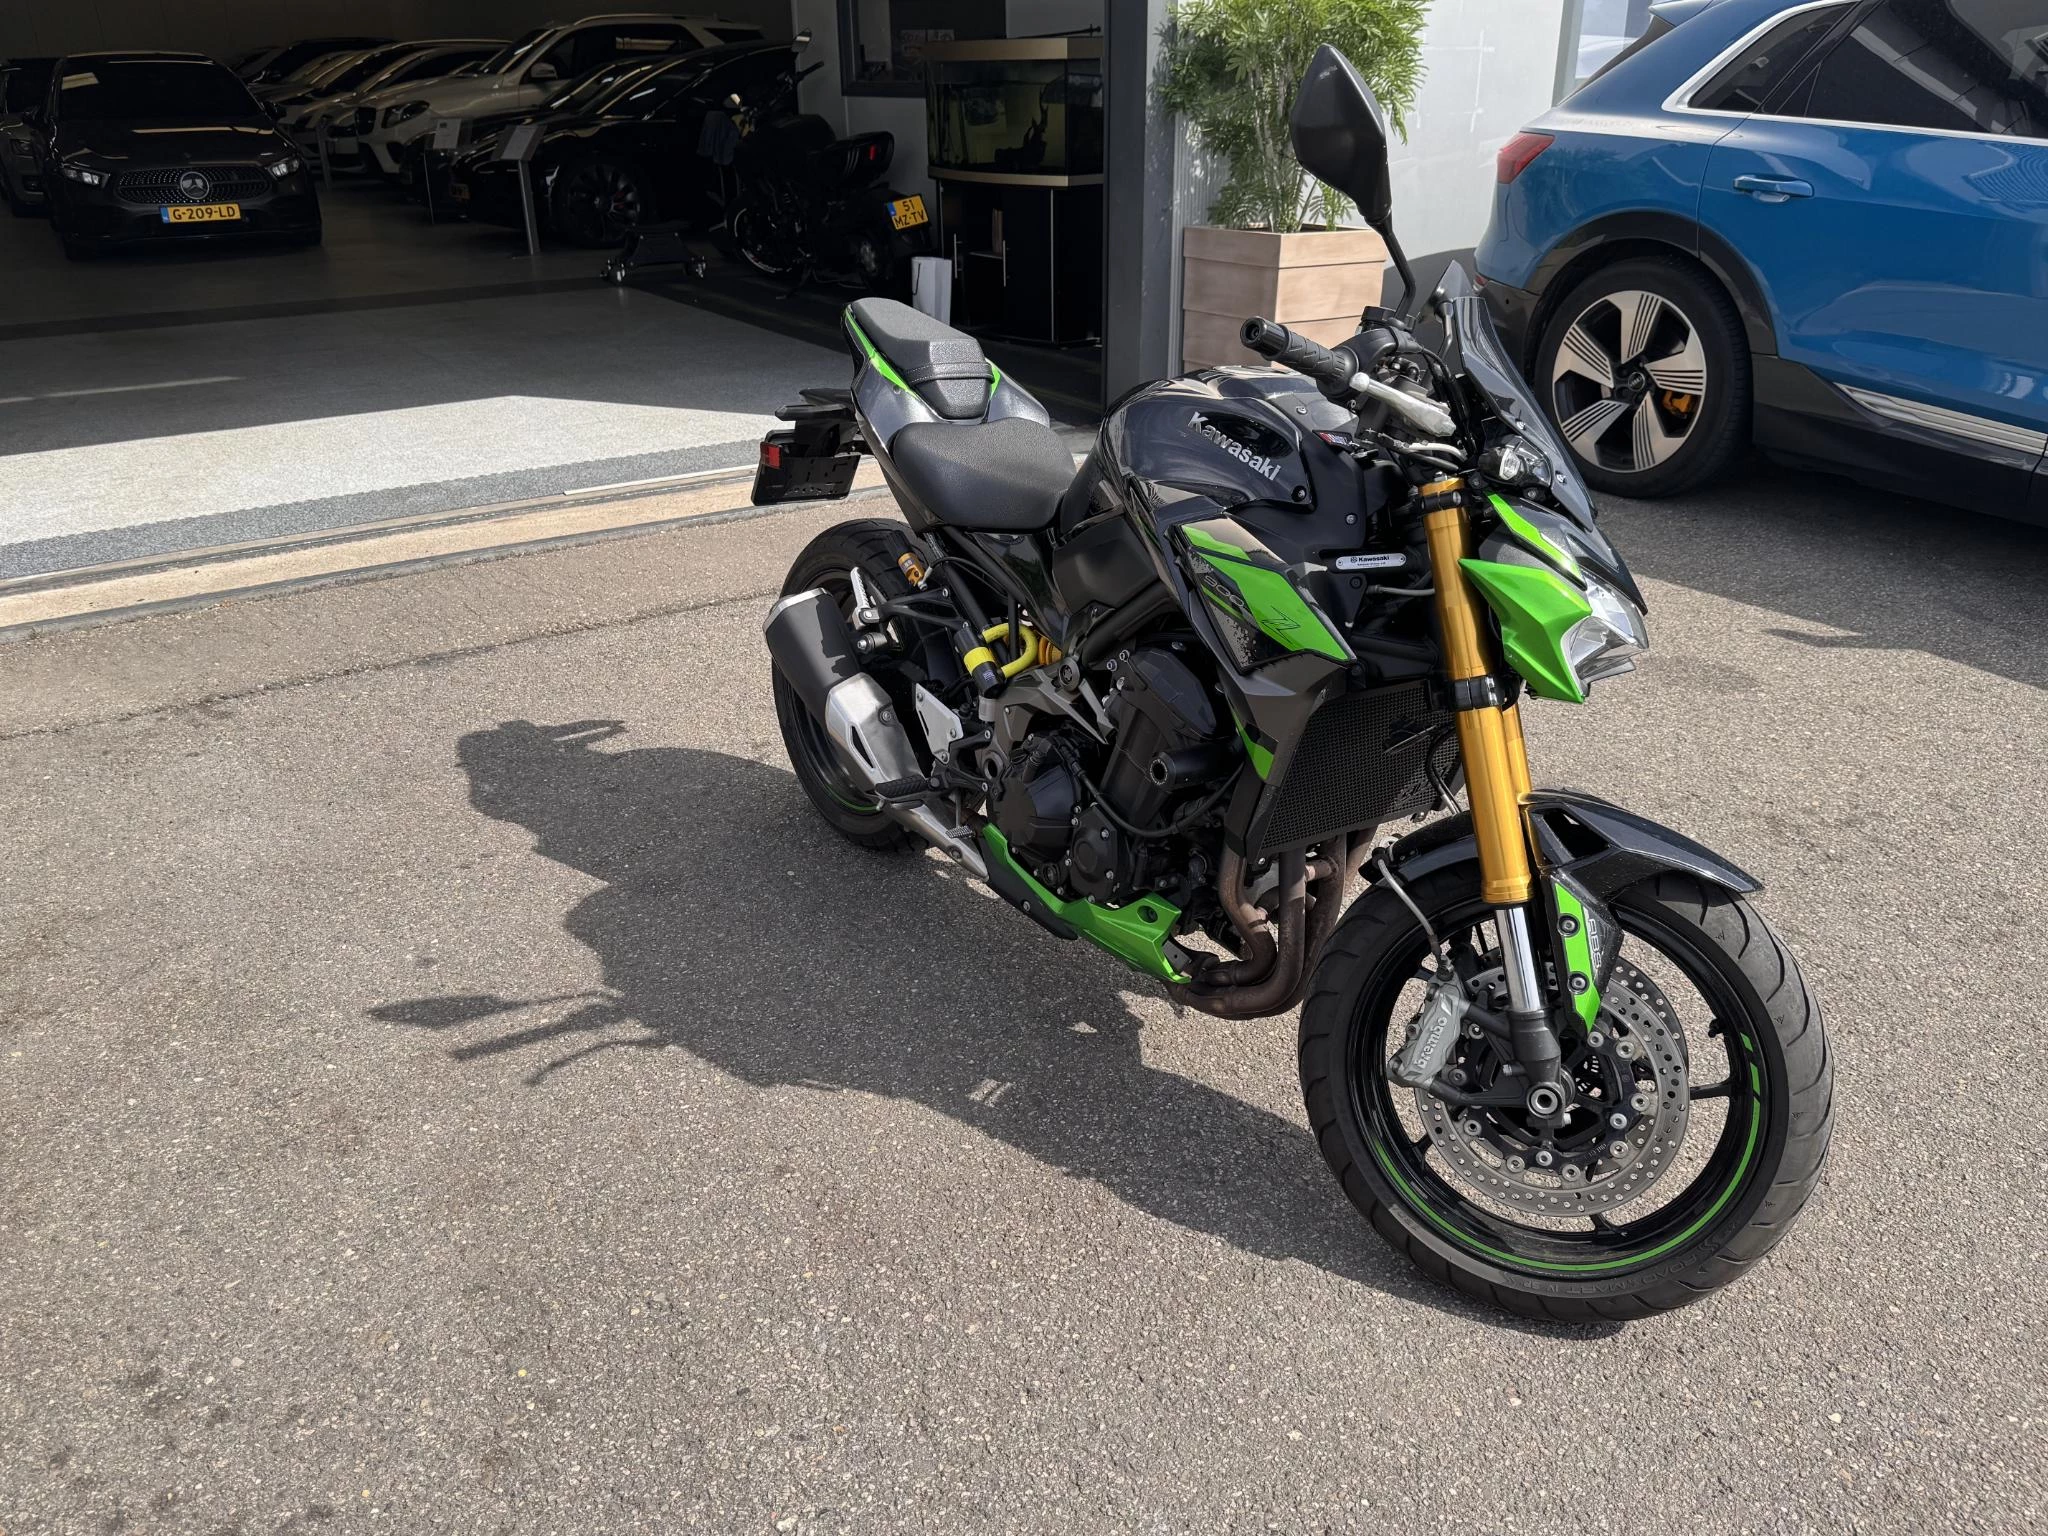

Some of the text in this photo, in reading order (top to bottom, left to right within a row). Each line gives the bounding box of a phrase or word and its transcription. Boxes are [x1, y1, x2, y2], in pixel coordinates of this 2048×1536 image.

[172, 206, 236, 220] G-209-LD
[902, 199, 915, 212] 51
[1187, 411, 1281, 481] Kawasaki
[1204, 575, 1245, 607] 900
[1588, 918, 1602, 969] ABS
[1413, 1016, 1448, 1070] brembo
